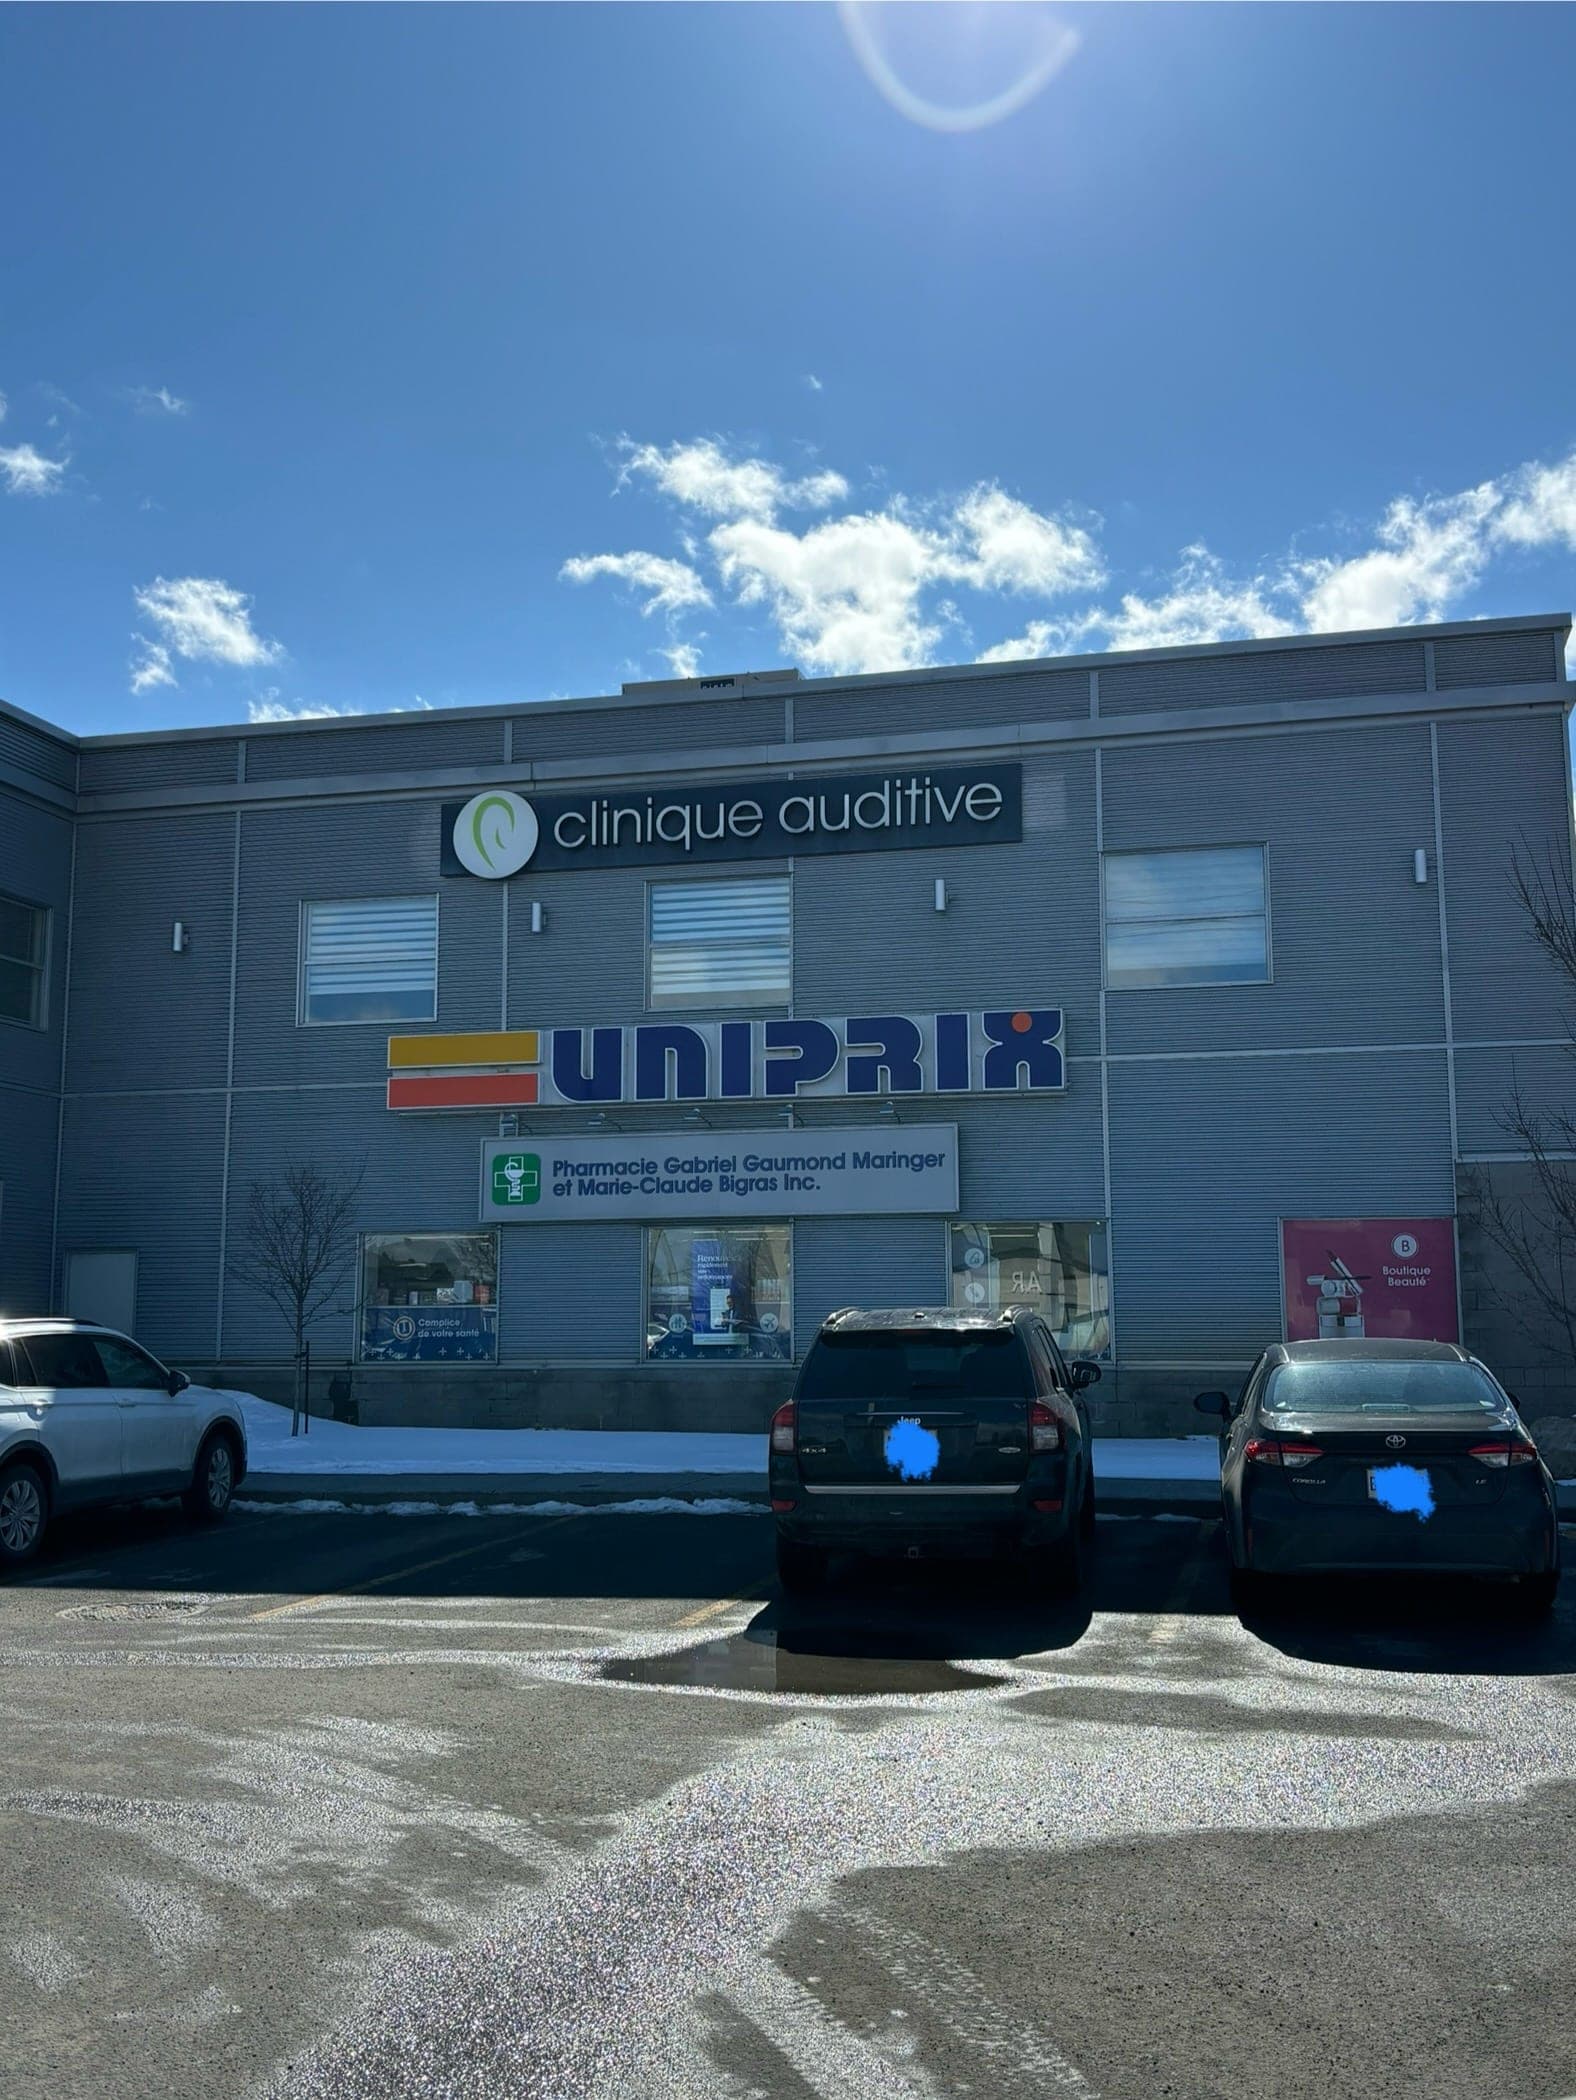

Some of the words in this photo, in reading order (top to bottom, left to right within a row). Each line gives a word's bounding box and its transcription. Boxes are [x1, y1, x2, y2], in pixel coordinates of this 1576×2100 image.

[554, 797, 763, 851] clinique
[778, 777, 1003, 834] auditive
[550, 1007, 1065, 1104] UNIPRIX
[552, 1157, 658, 1178] Pharmacie
[663, 1154, 737, 1176] Gabriel
[742, 1152, 847, 1174] Gaumond
[852, 1150, 946, 1173] Maringer
[552, 1178, 574, 1197] et
[577, 1174, 714, 1197] Marie-Claude
[718, 1173, 778, 1197] Bigras
[783, 1172, 822, 1192] Inc.
[1401, 1240, 1411, 1252] B
[1382, 1265, 1431, 1279] Boutique
[1387, 1275, 1427, 1287] Beauté
[417, 1318, 461, 1329] Complice
[417, 1328, 430, 1338] de
[431, 1329, 454, 1338] votre
[455, 1328, 480, 1338] santé
